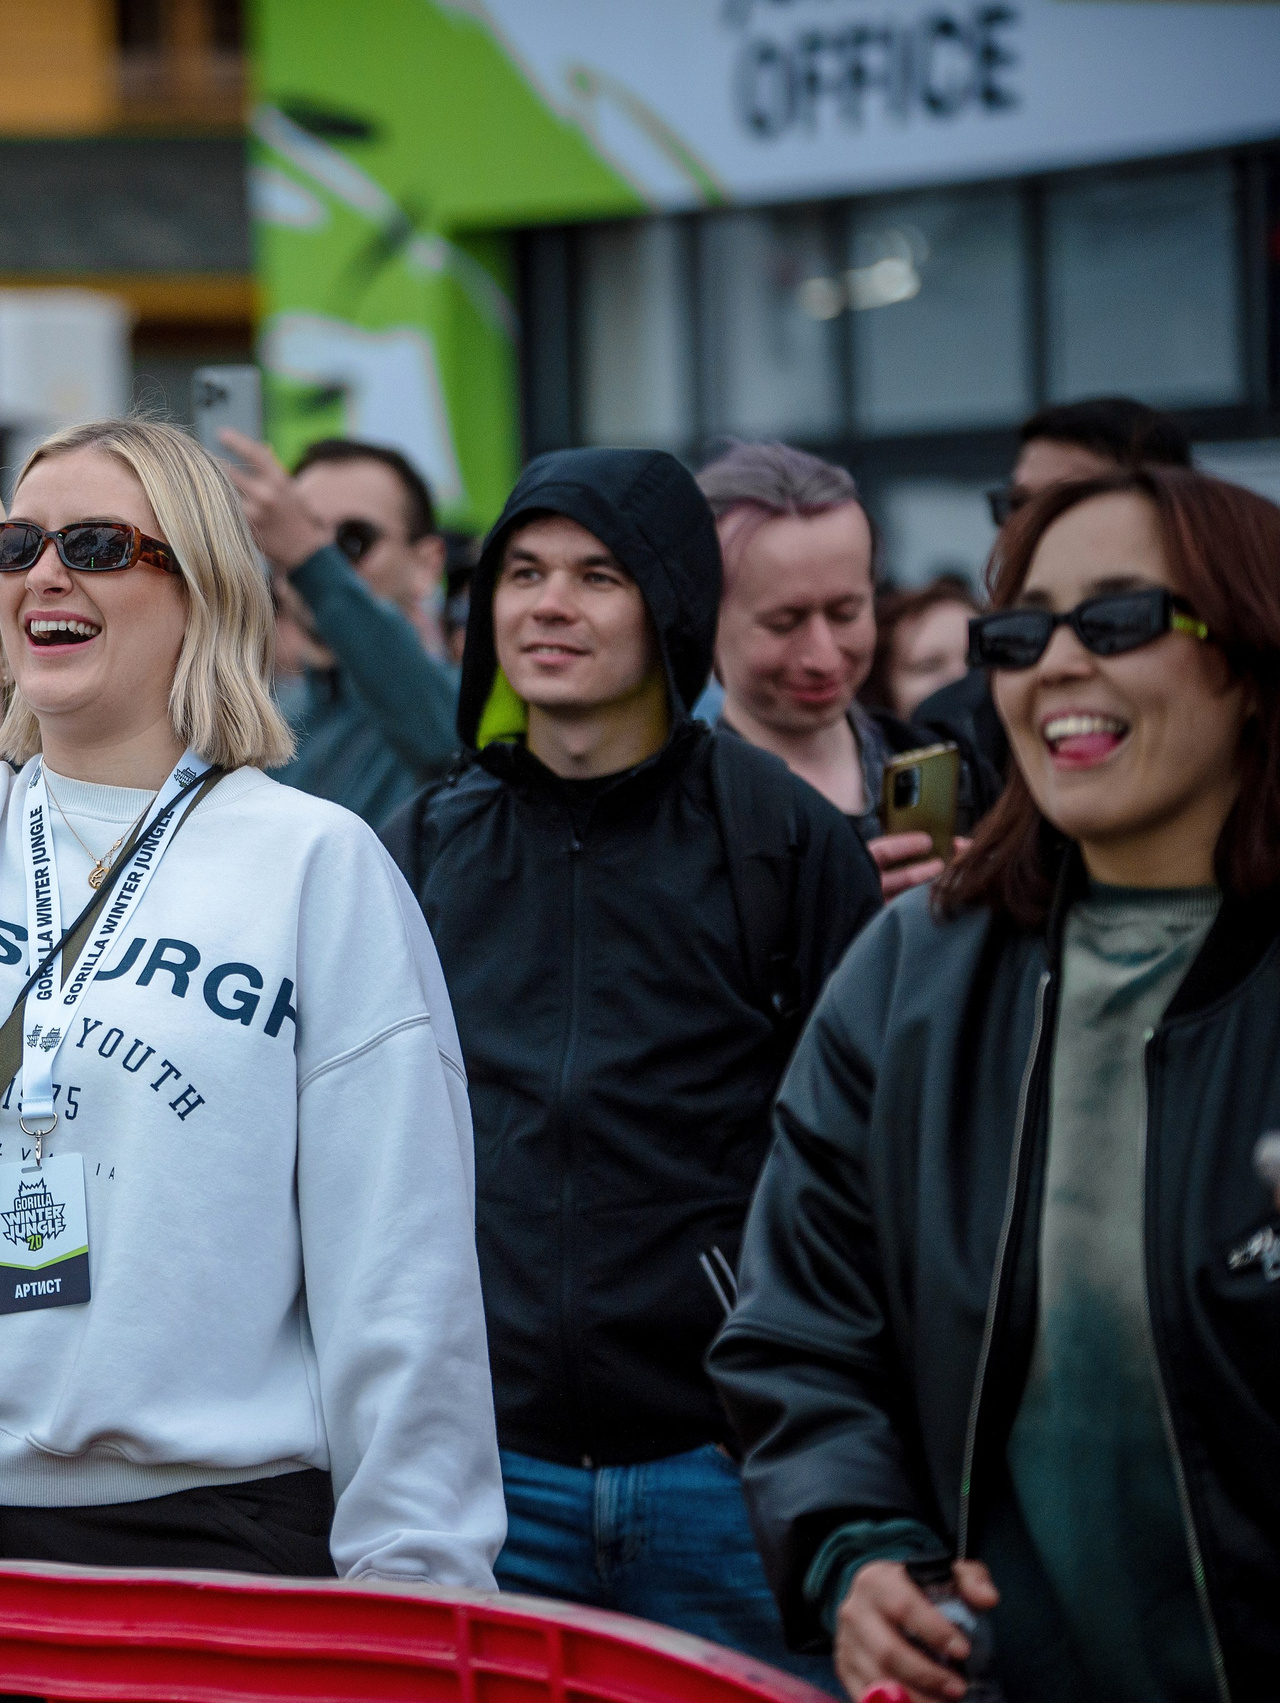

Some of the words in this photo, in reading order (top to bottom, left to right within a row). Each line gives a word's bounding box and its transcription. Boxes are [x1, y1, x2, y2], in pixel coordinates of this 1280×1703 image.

[732, 3, 1020, 142] OFFICE
[29, 805, 51, 866] JUNGLE
[34, 866, 53, 928] WINTER
[63, 938, 111, 1006] GORILLA
[100, 871, 145, 935] WINTER
[76, 1017, 206, 1121] YOUTH
[2, 1077, 81, 1120] 175
[2, 1204, 65, 1226] WINTER
[14, 1194, 53, 1211] GORILLA
[4, 1218, 65, 1243] JUNGLE
[15, 1278, 62, 1299] АРТИСТ
